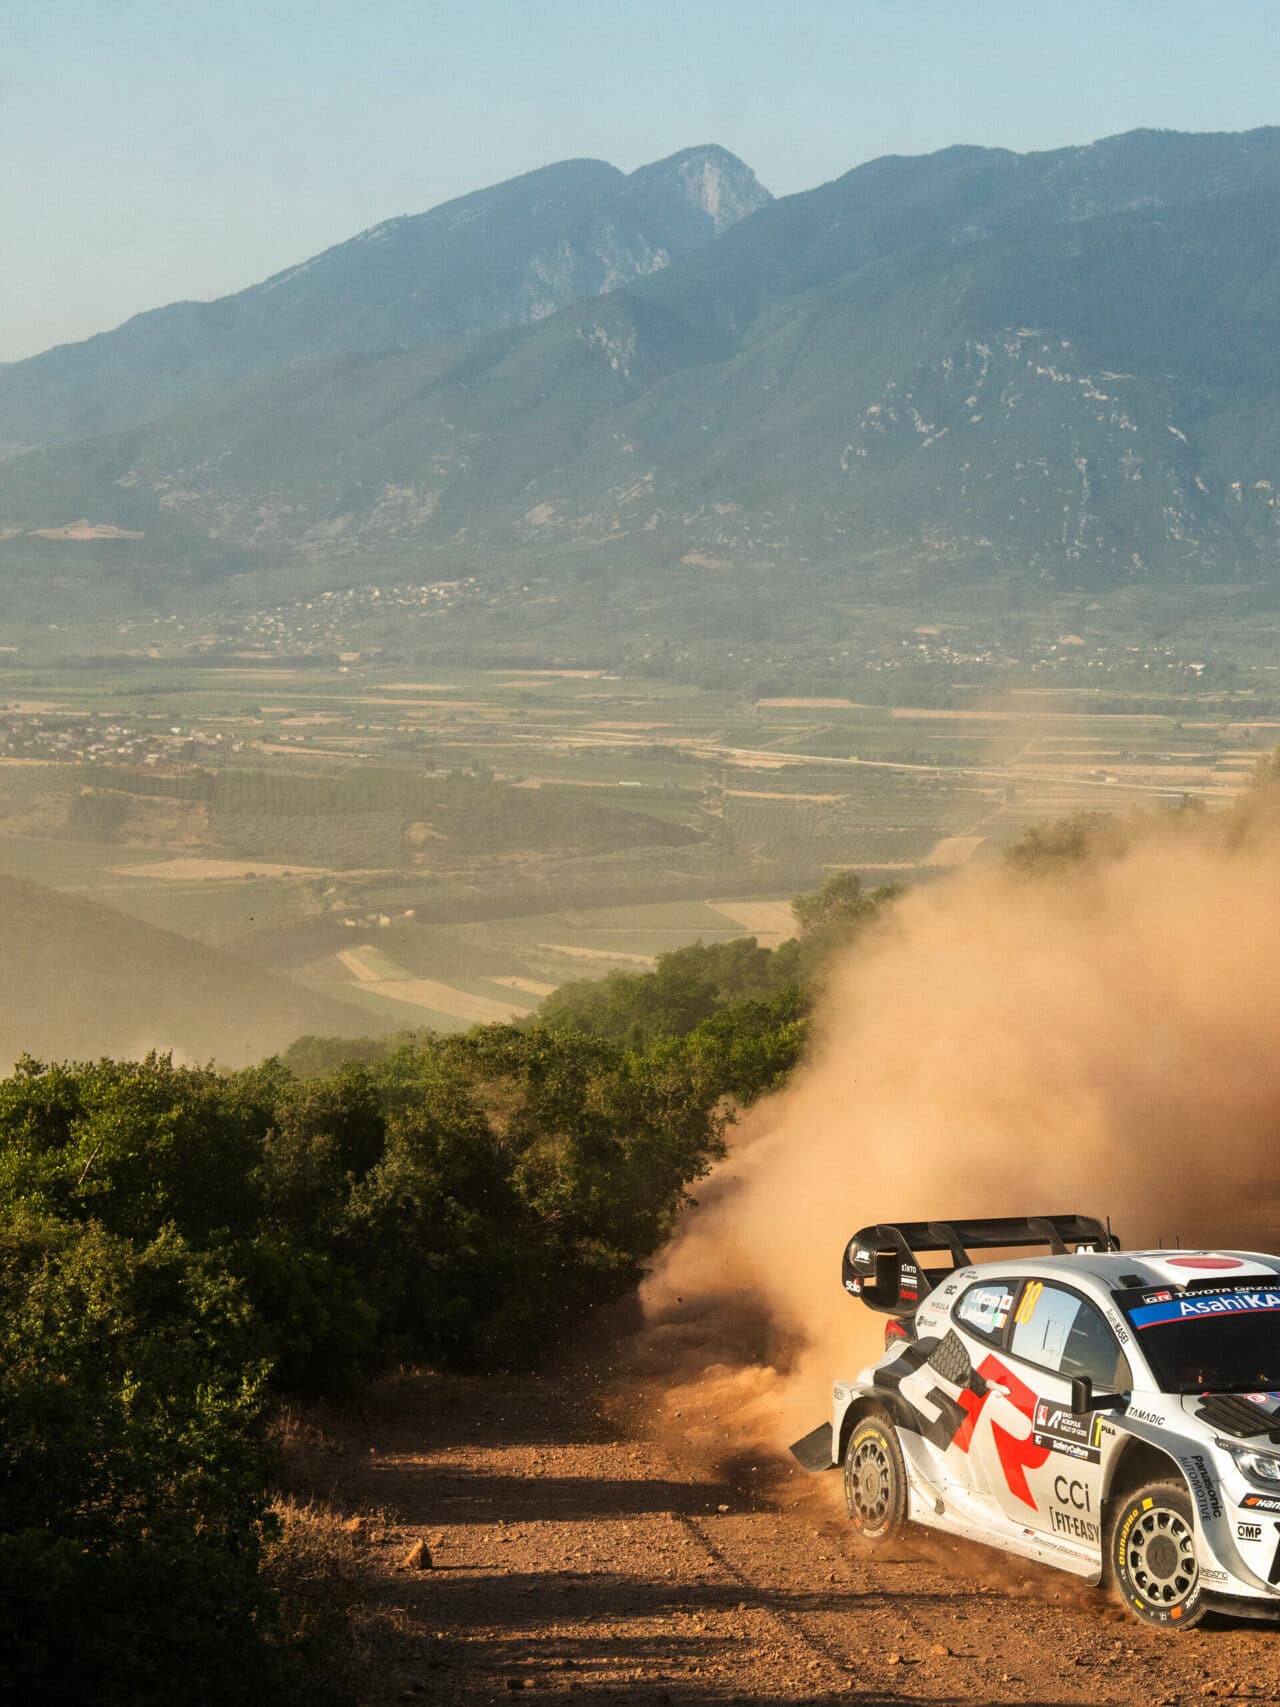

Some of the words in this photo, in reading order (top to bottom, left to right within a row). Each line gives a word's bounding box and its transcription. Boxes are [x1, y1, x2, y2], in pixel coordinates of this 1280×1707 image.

[1014, 1280, 1043, 1325] 18
[1144, 1292, 1173, 1305] GR
[1175, 1287, 1232, 1299] TOYOTA
[1128, 1406, 1166, 1427] TAMADIC
[1101, 1425, 1117, 1437] PIAA
[1178, 1456, 1212, 1522] AUTOMOTIVE
[1191, 1454, 1222, 1519] Panasonic
[1237, 1525, 1262, 1539] OMP
